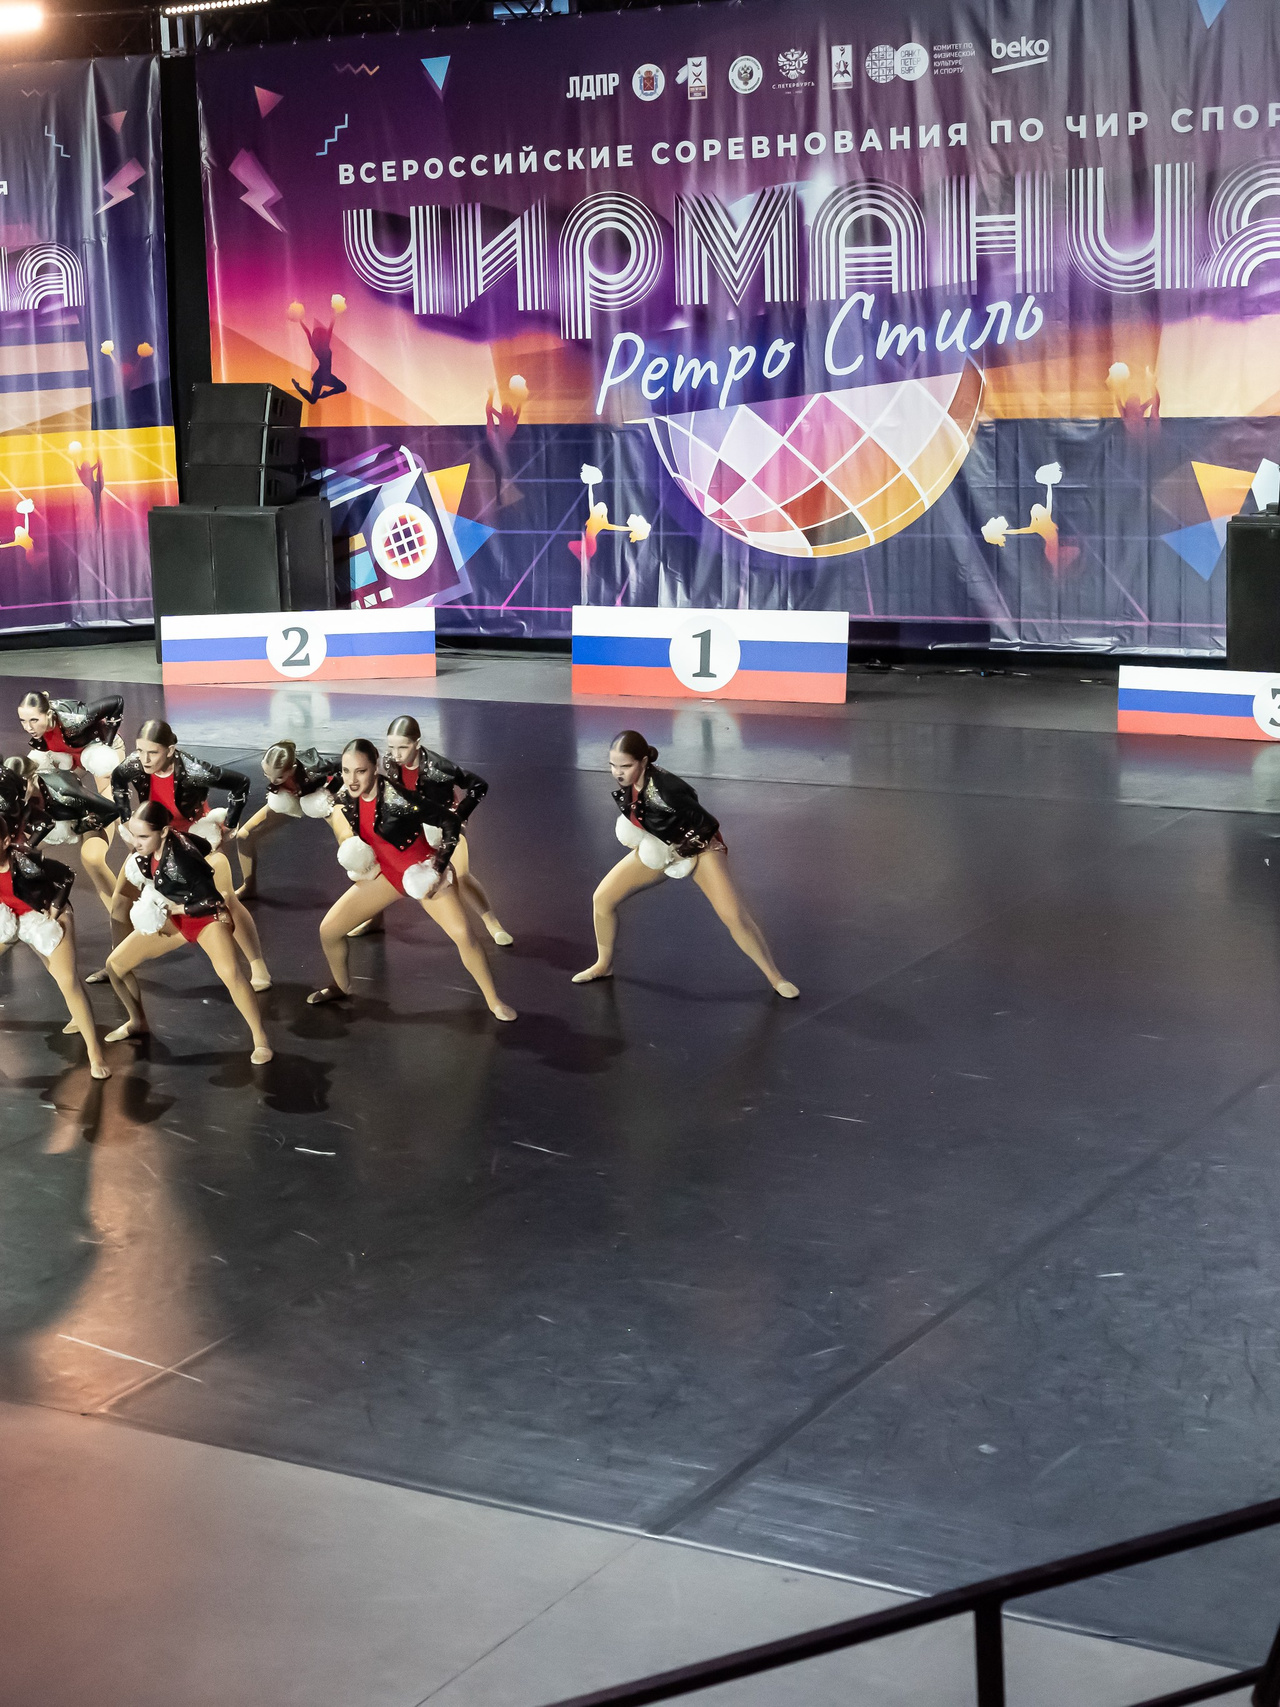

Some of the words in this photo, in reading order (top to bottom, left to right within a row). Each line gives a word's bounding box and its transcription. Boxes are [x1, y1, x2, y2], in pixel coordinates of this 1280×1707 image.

[933, 43, 962, 51] КОМИТЕТ
[933, 48, 976, 59] ФИЗИЧЕСКОЙ
[990, 36, 1050, 59] beko
[939, 66, 965, 75] СПОРТУ
[566, 73, 620, 101] ЛДПР
[338, 145, 634, 185] ВСЕРОССИЙСКИЕ
[651, 122, 968, 165] СОРЕВНОВАНИЯ
[990, 117, 1045, 144] ПО
[1065, 111, 1149, 139] ЧИР
[595, 331, 796, 416] Ретро
[824, 291, 1044, 377] Стиль
[281, 627, 312, 668] 2
[692, 629, 718, 680] 1
